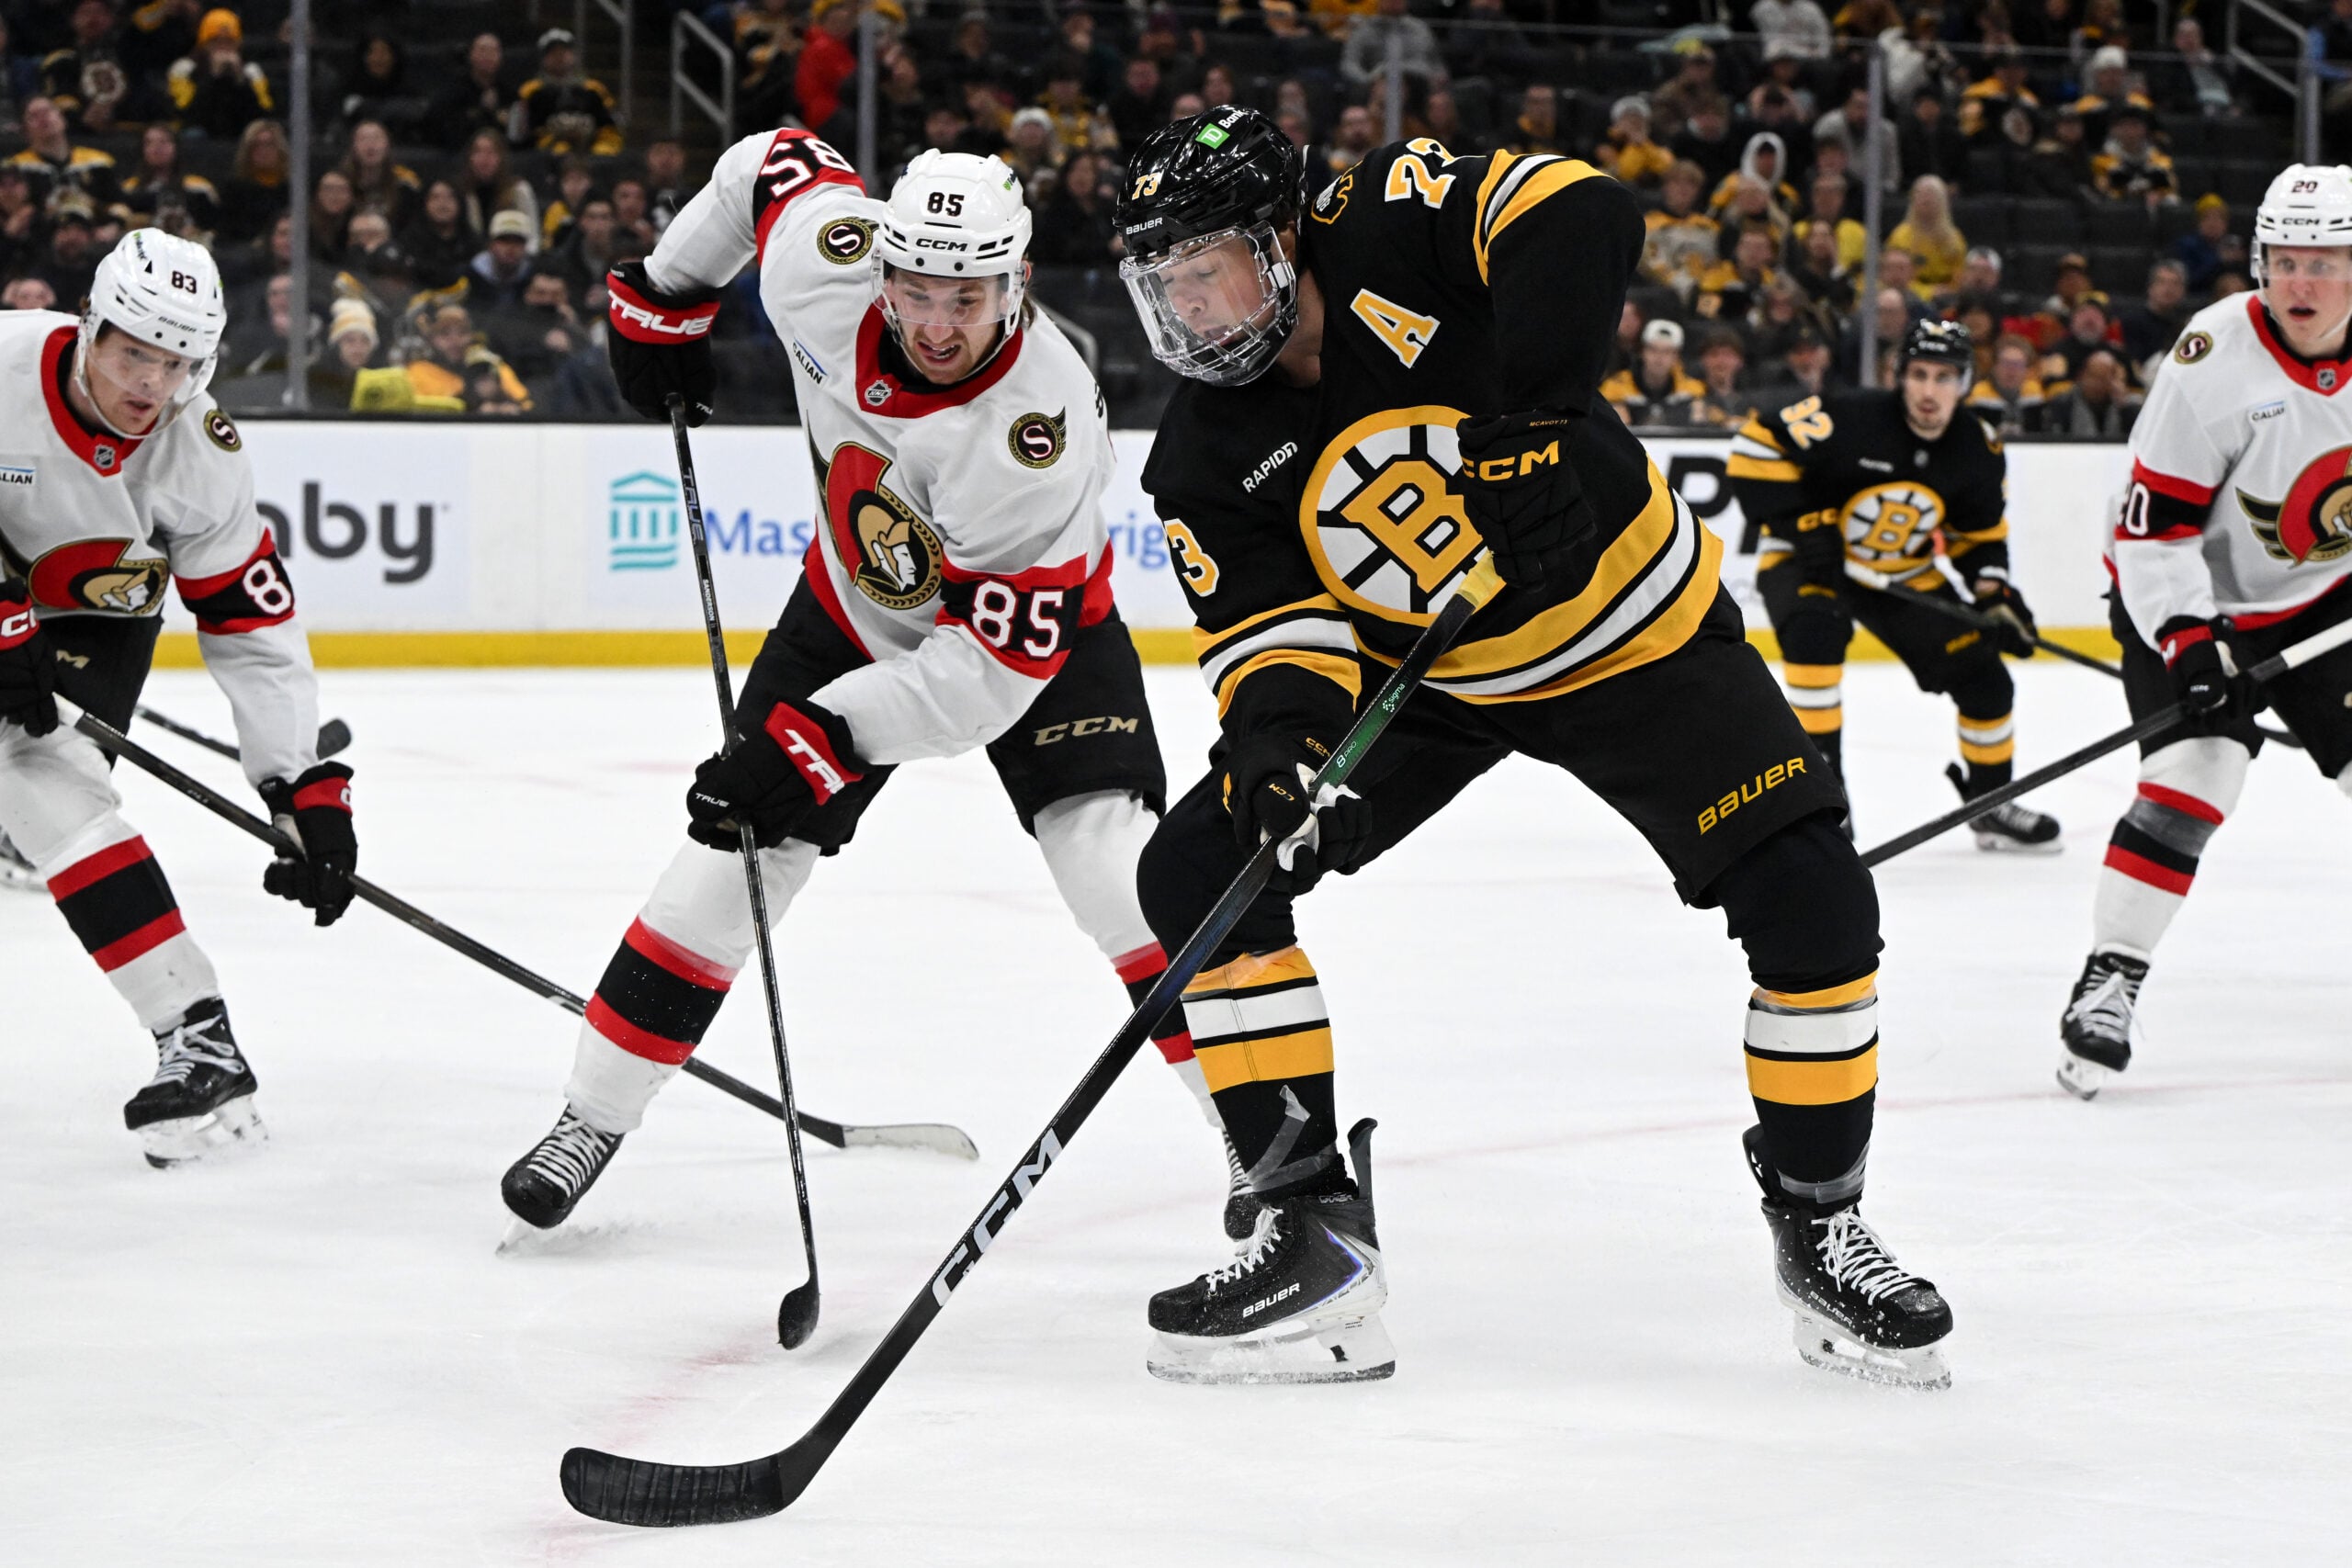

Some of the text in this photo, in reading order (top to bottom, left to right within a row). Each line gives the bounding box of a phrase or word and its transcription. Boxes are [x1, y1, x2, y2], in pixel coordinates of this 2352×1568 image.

[1131, 172, 1161, 200] 73
[2291, 180, 2318, 193] 20
[927, 192, 965, 217] 85
[2282, 218, 2320, 226] CCM
[916, 239, 967, 252] CCM
[171, 270, 198, 295] 83
[608, 288, 714, 335] TRUE
[1350, 288, 1441, 368] A
[792, 342, 822, 384] CALIAN
[0, 472, 33, 485] LIAN
[1242, 442, 1298, 492] RAPID7
[1340, 460, 1483, 593] B
[702, 579, 715, 622] SANDERSON
[971, 580, 1064, 659] 85
[1388, 682, 1406, 704] sigma
[1034, 716, 1138, 746] CCM
[1337, 741, 1357, 767] 8 PRO
[695, 792, 729, 807] TRUE
[932, 1127, 1064, 1308] CCM
